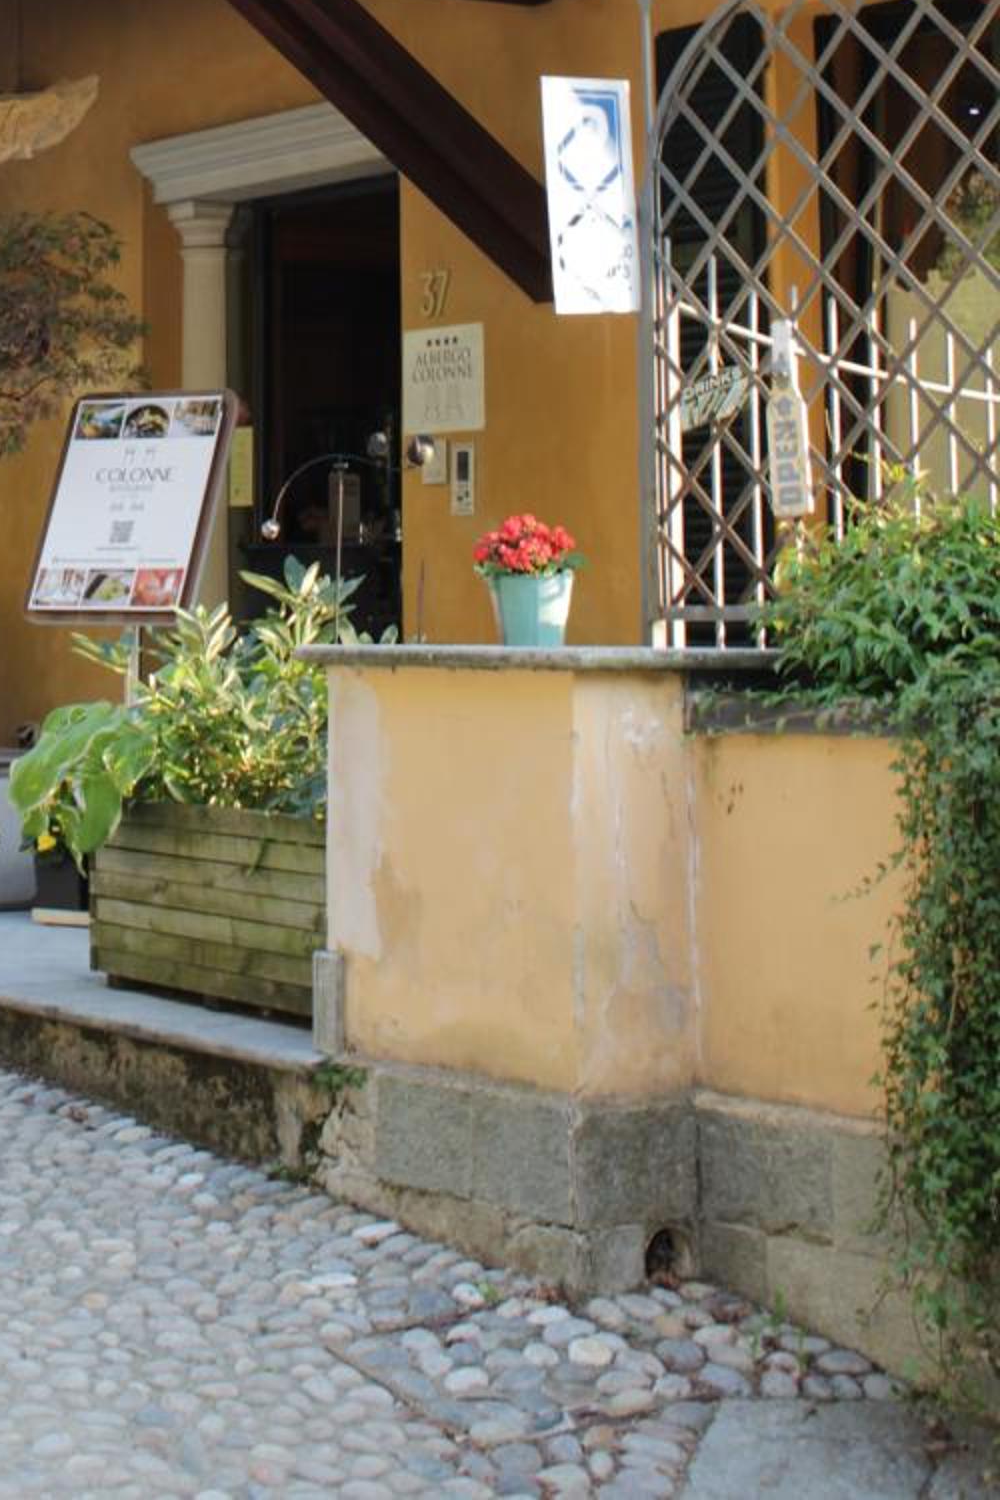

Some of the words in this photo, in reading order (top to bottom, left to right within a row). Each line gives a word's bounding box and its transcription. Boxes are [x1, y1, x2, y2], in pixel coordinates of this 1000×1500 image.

[420, 268, 449, 318] 37
[415, 346, 472, 367] ALBERGO
[411, 362, 473, 385] COLONNE
[96, 467, 173, 483] COLONNE
[774, 420, 802, 507] OPEN
